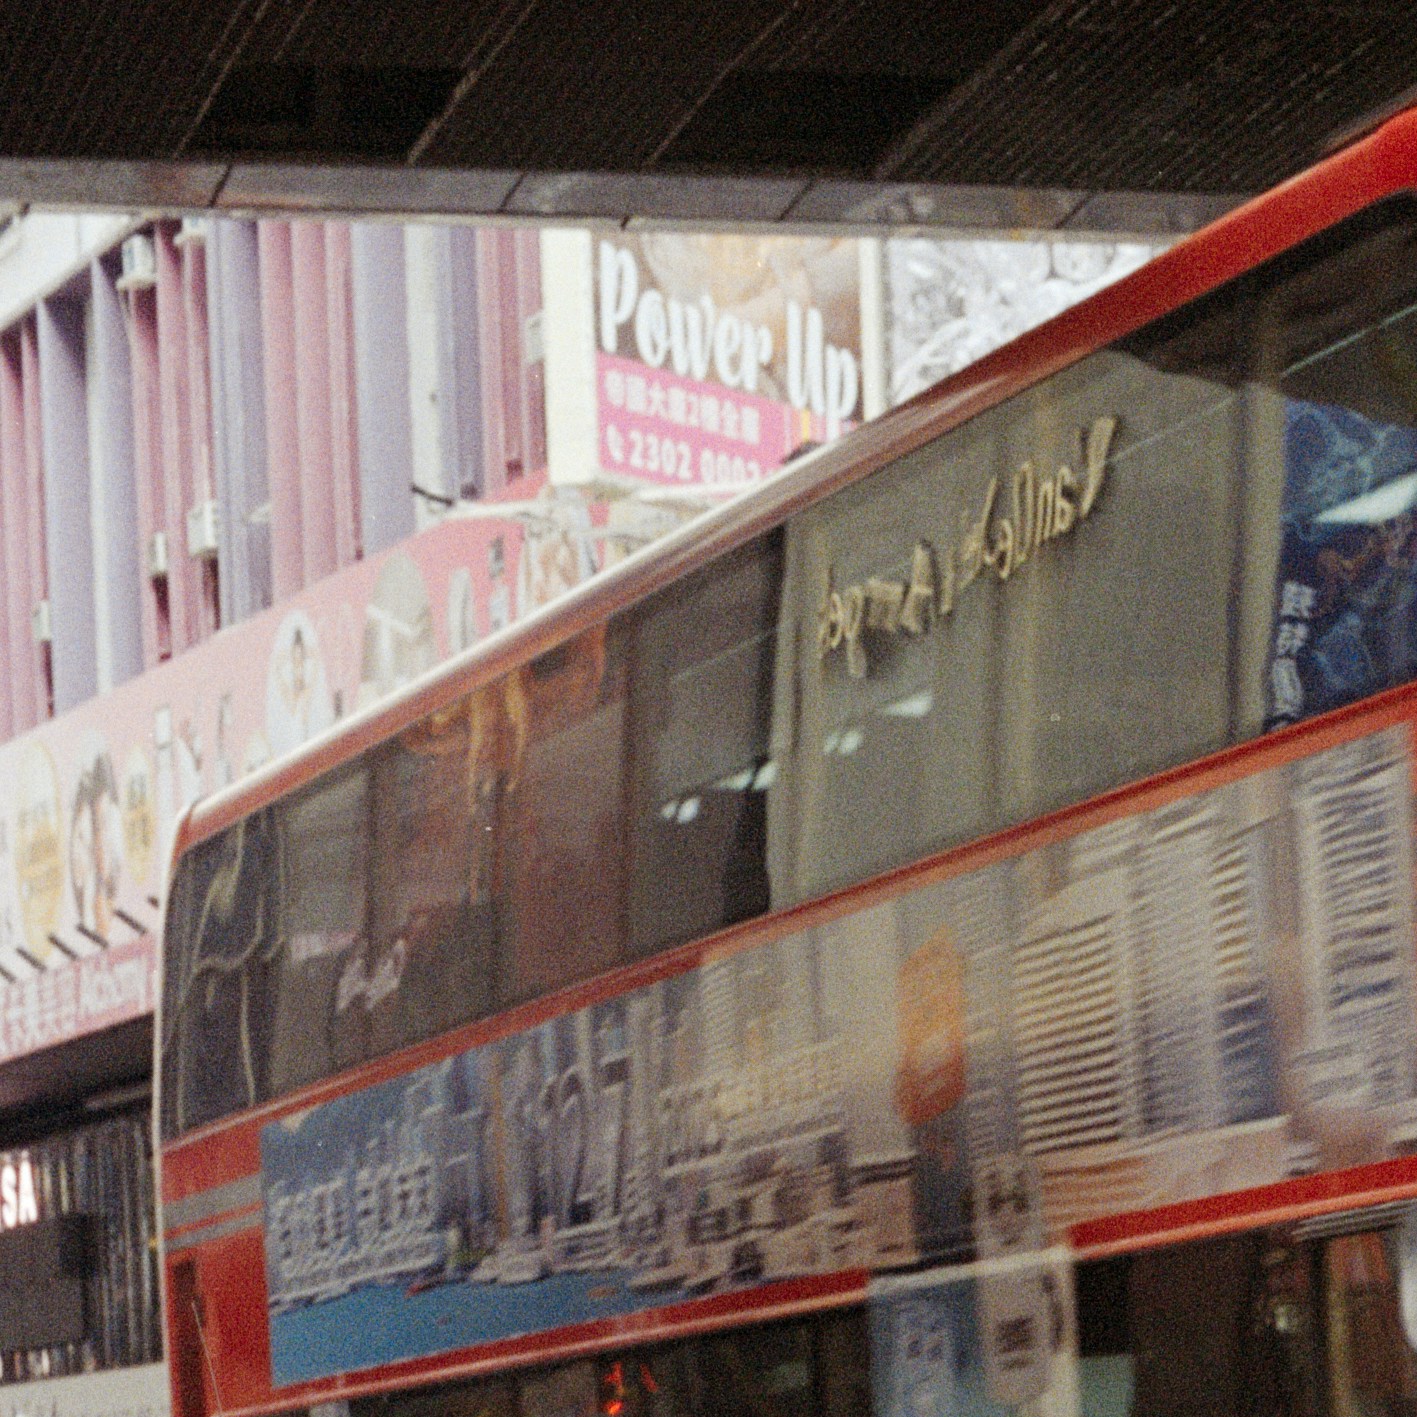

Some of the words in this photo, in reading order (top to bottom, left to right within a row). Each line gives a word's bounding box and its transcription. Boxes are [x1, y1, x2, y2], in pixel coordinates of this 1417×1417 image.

[600, 240, 773, 392] Power
[787, 300, 857, 441] Up
[0, 1156, 38, 1229] SA
